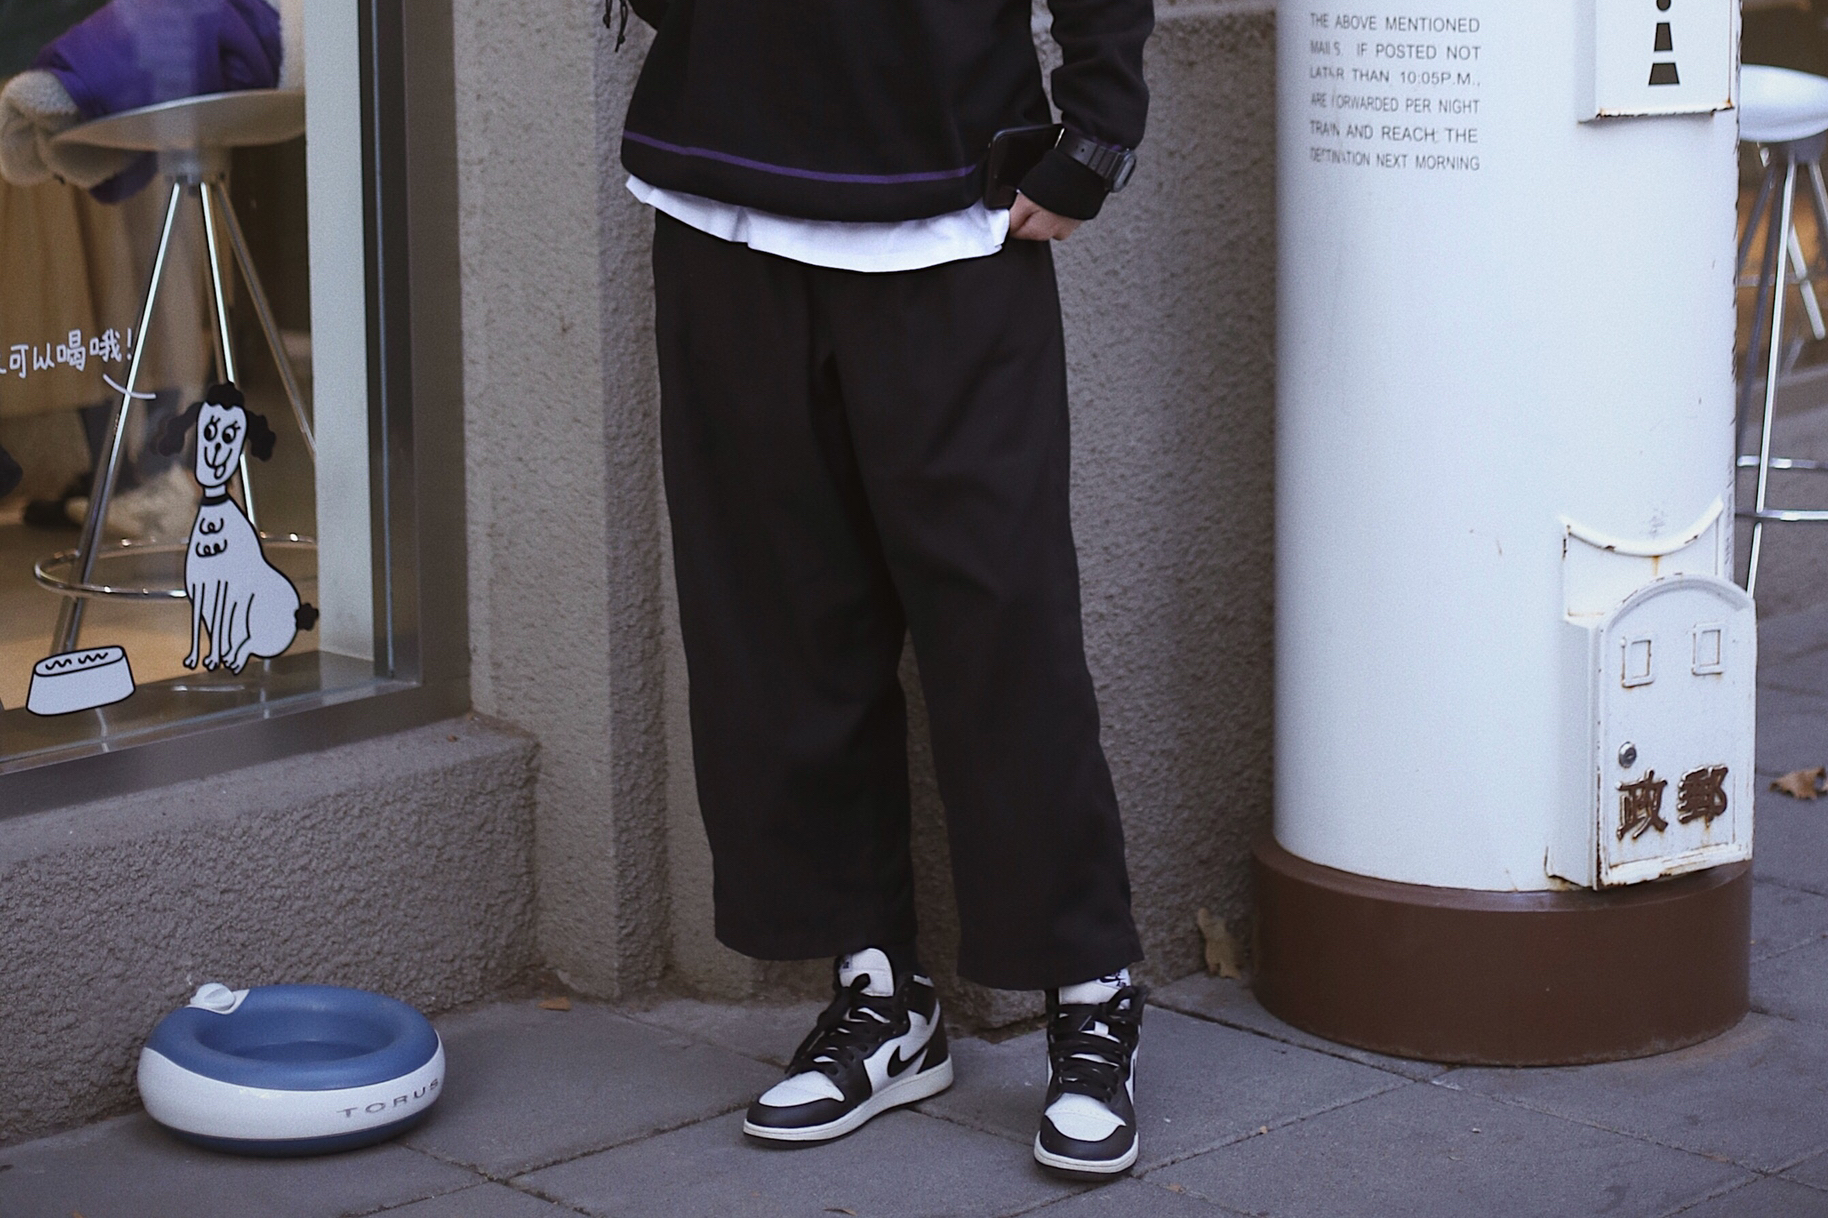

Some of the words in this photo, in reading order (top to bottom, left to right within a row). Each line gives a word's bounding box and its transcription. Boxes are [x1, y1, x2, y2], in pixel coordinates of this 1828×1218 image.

[1309, 11, 1329, 29] THE
[1334, 13, 1378, 32] ABOVE
[1384, 15, 1481, 34] MENTIONED
[1356, 41, 1368, 57] IF
[1375, 42, 1438, 61] POSTED
[1446, 44, 1482, 61] NOT
[1351, 67, 1390, 84] THAN
[1404, 97, 1432, 114] PER
[1438, 97, 1481, 115] NIGHT
[1345, 123, 1374, 141] AND
[1444, 127, 1478, 144] THE
[1375, 152, 1409, 169] NEXT
[1414, 154, 1481, 172] MORNING
[336, 1078, 439, 1118] TORUS
